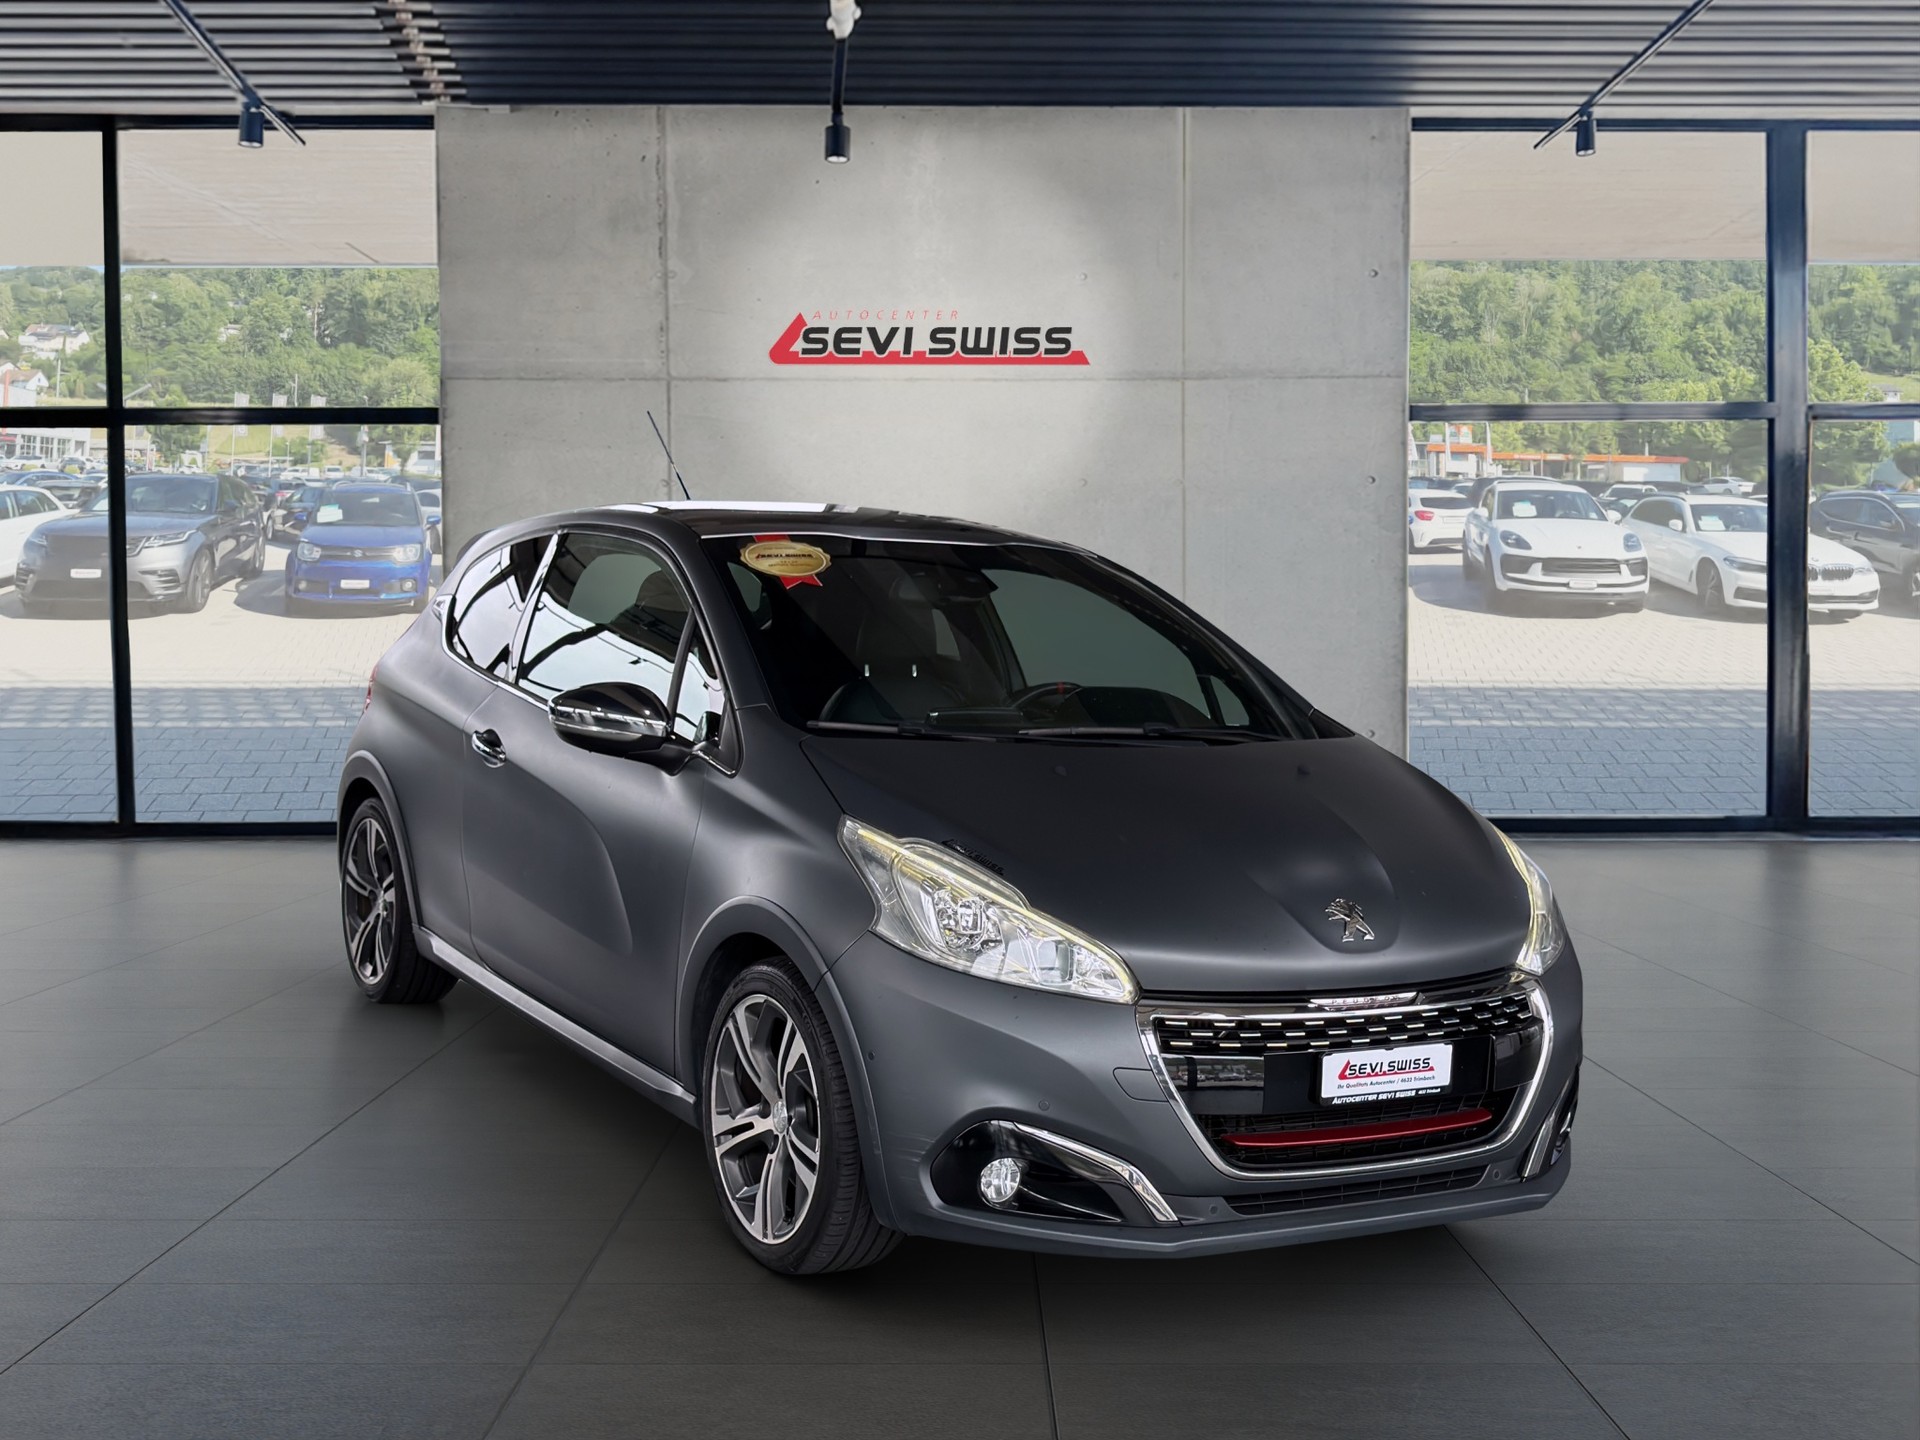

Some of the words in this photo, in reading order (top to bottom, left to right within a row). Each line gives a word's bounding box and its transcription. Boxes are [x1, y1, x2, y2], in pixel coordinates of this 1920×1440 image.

[813, 310, 959, 321] AUTOCENTER
[801, 327, 914, 355] SEVI
[929, 327, 1072, 355] SWISS
[1348, 1062, 1383, 1076] SEVI
[1388, 1058, 1431, 1072] SWISS
[1378, 1091, 1395, 1100] SEVI
